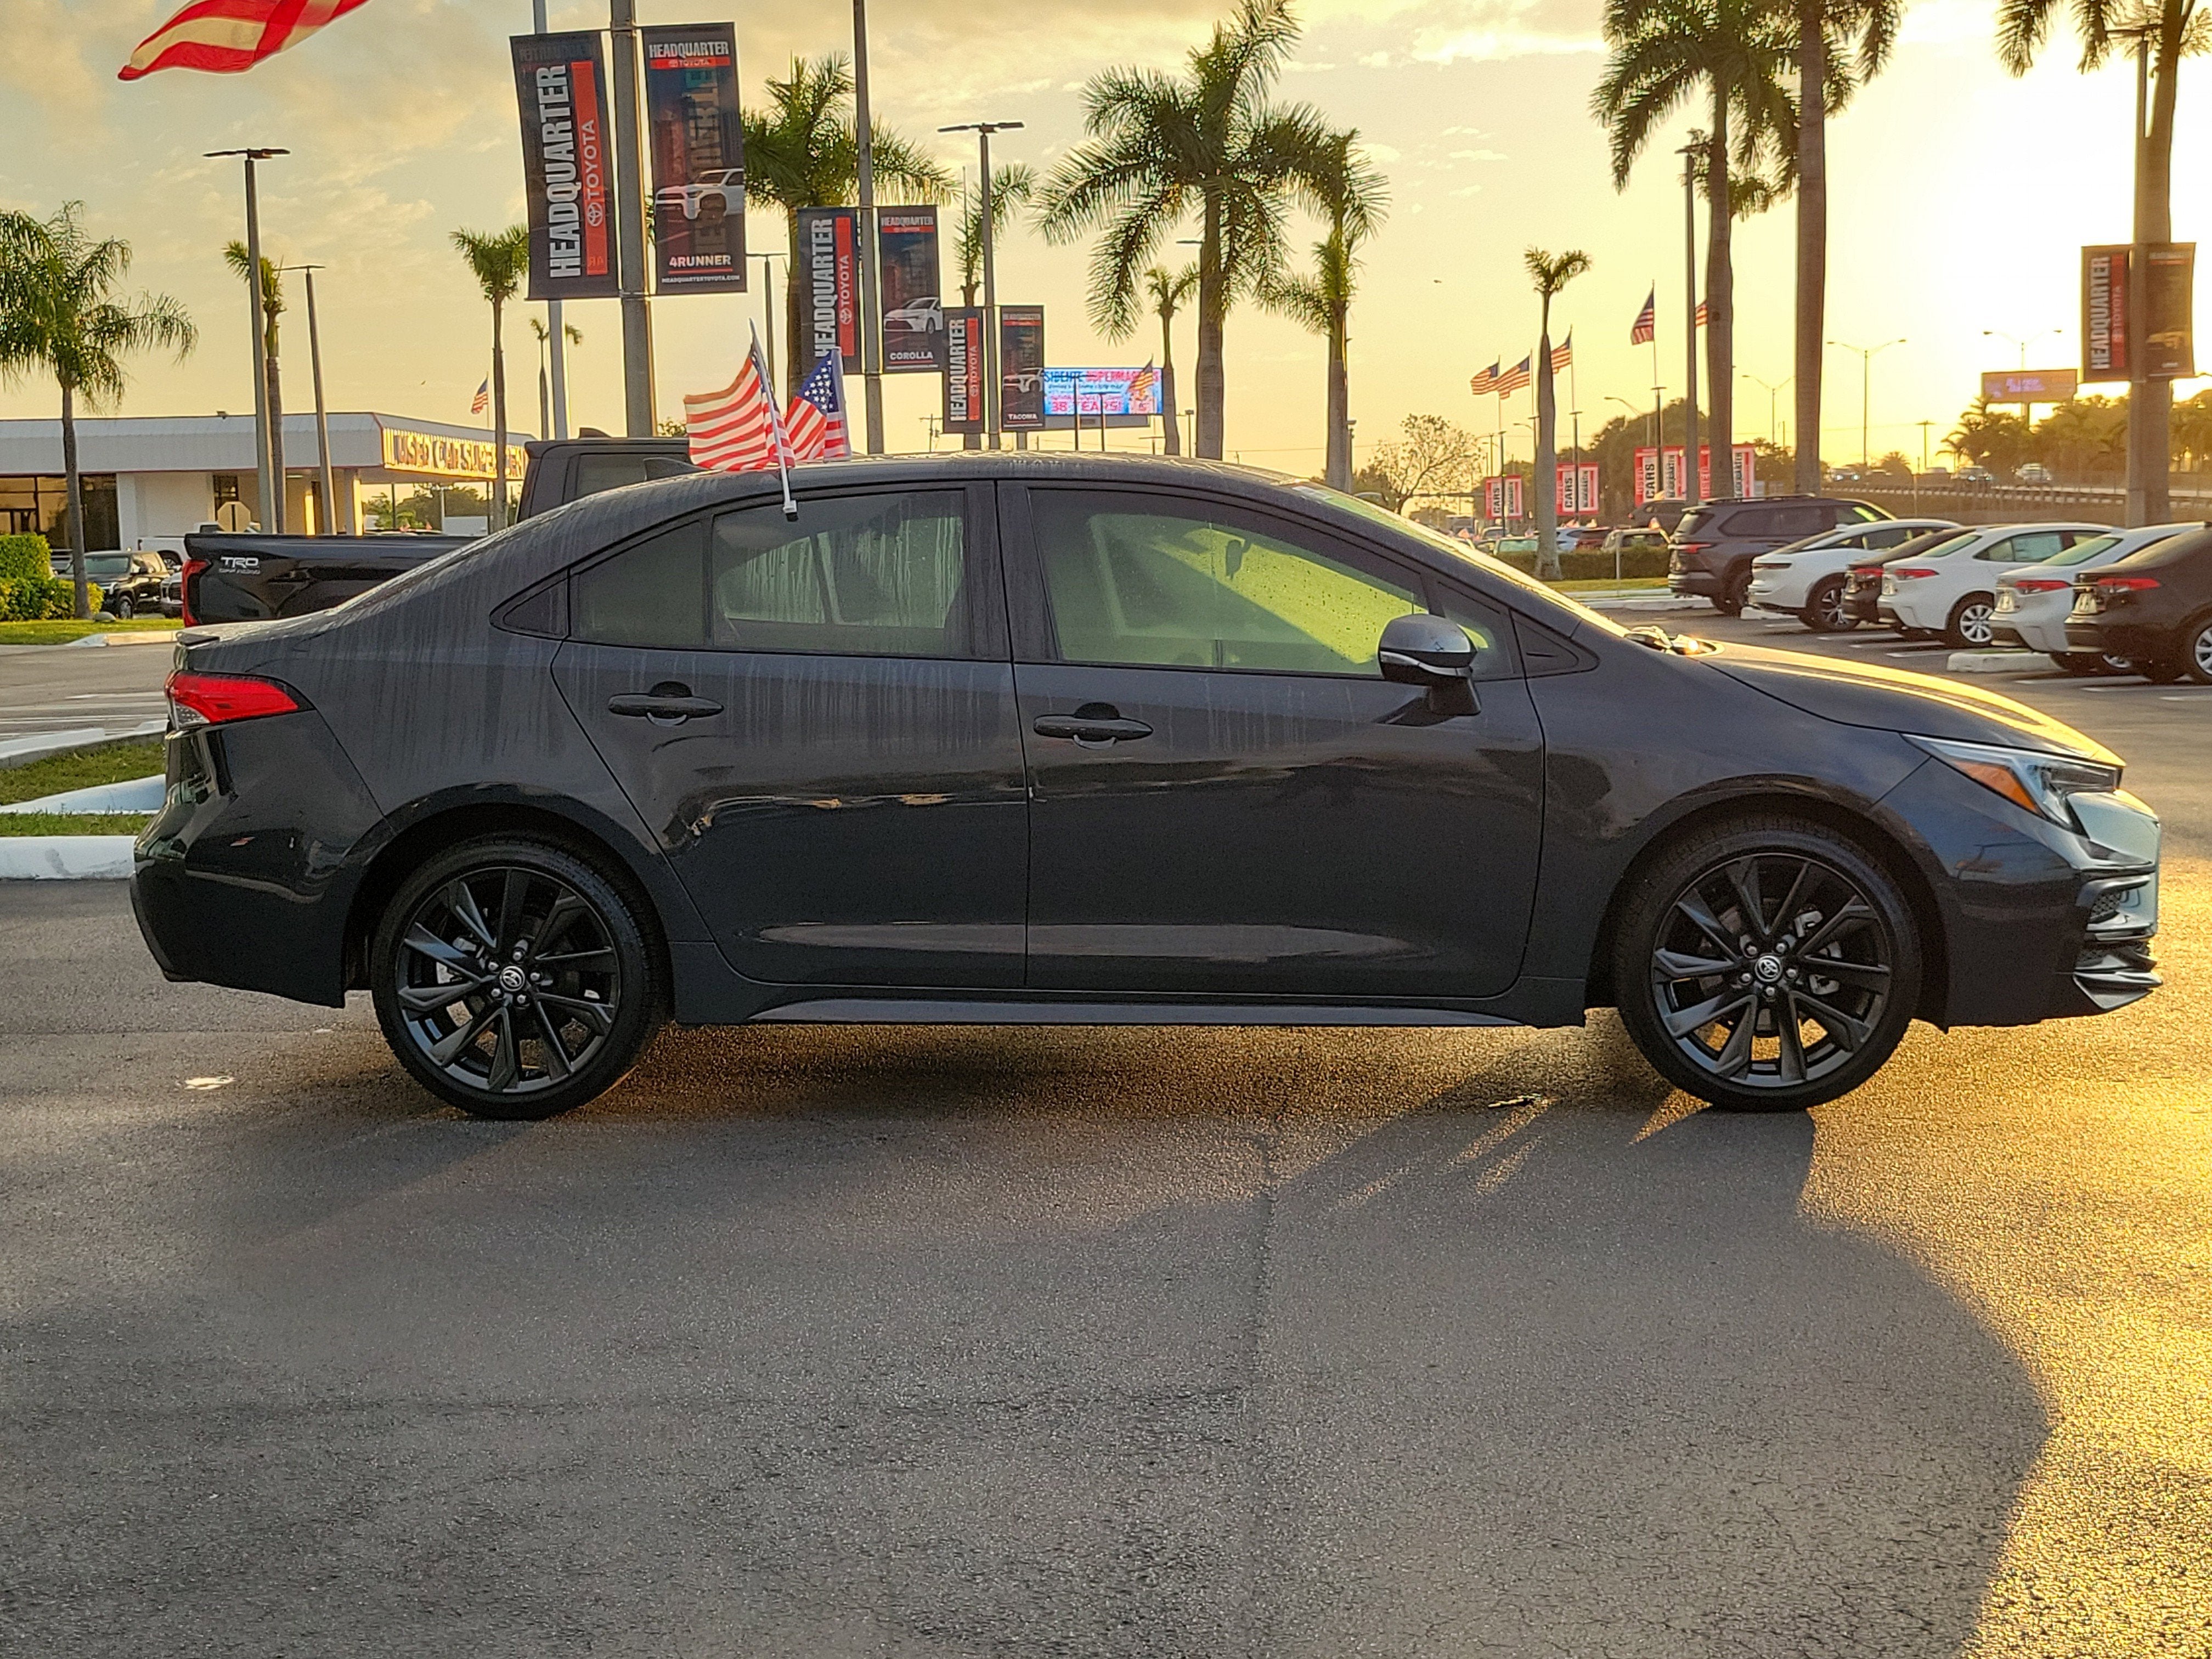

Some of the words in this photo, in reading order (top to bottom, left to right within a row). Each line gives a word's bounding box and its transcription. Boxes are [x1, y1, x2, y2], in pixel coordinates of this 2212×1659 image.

[649, 41, 729, 58] HEADQUARTER
[536, 65, 582, 278] HEADQUARTER
[580, 120, 600, 200] TOYOTA
[669, 255, 731, 267] 4RUNNER
[811, 218, 838, 357] HEADQUARTER
[839, 255, 850, 307] TOYOTA
[2090, 256, 2111, 370] HEADQUARTER
[889, 351, 933, 360] COROLLA
[949, 319, 968, 421] HEADQUARTER
[969, 346, 978, 383] TOYOTA
[1052, 401, 1068, 411] 38
[1646, 464, 1655, 499] CARS
[221, 556, 258, 568] TRD
